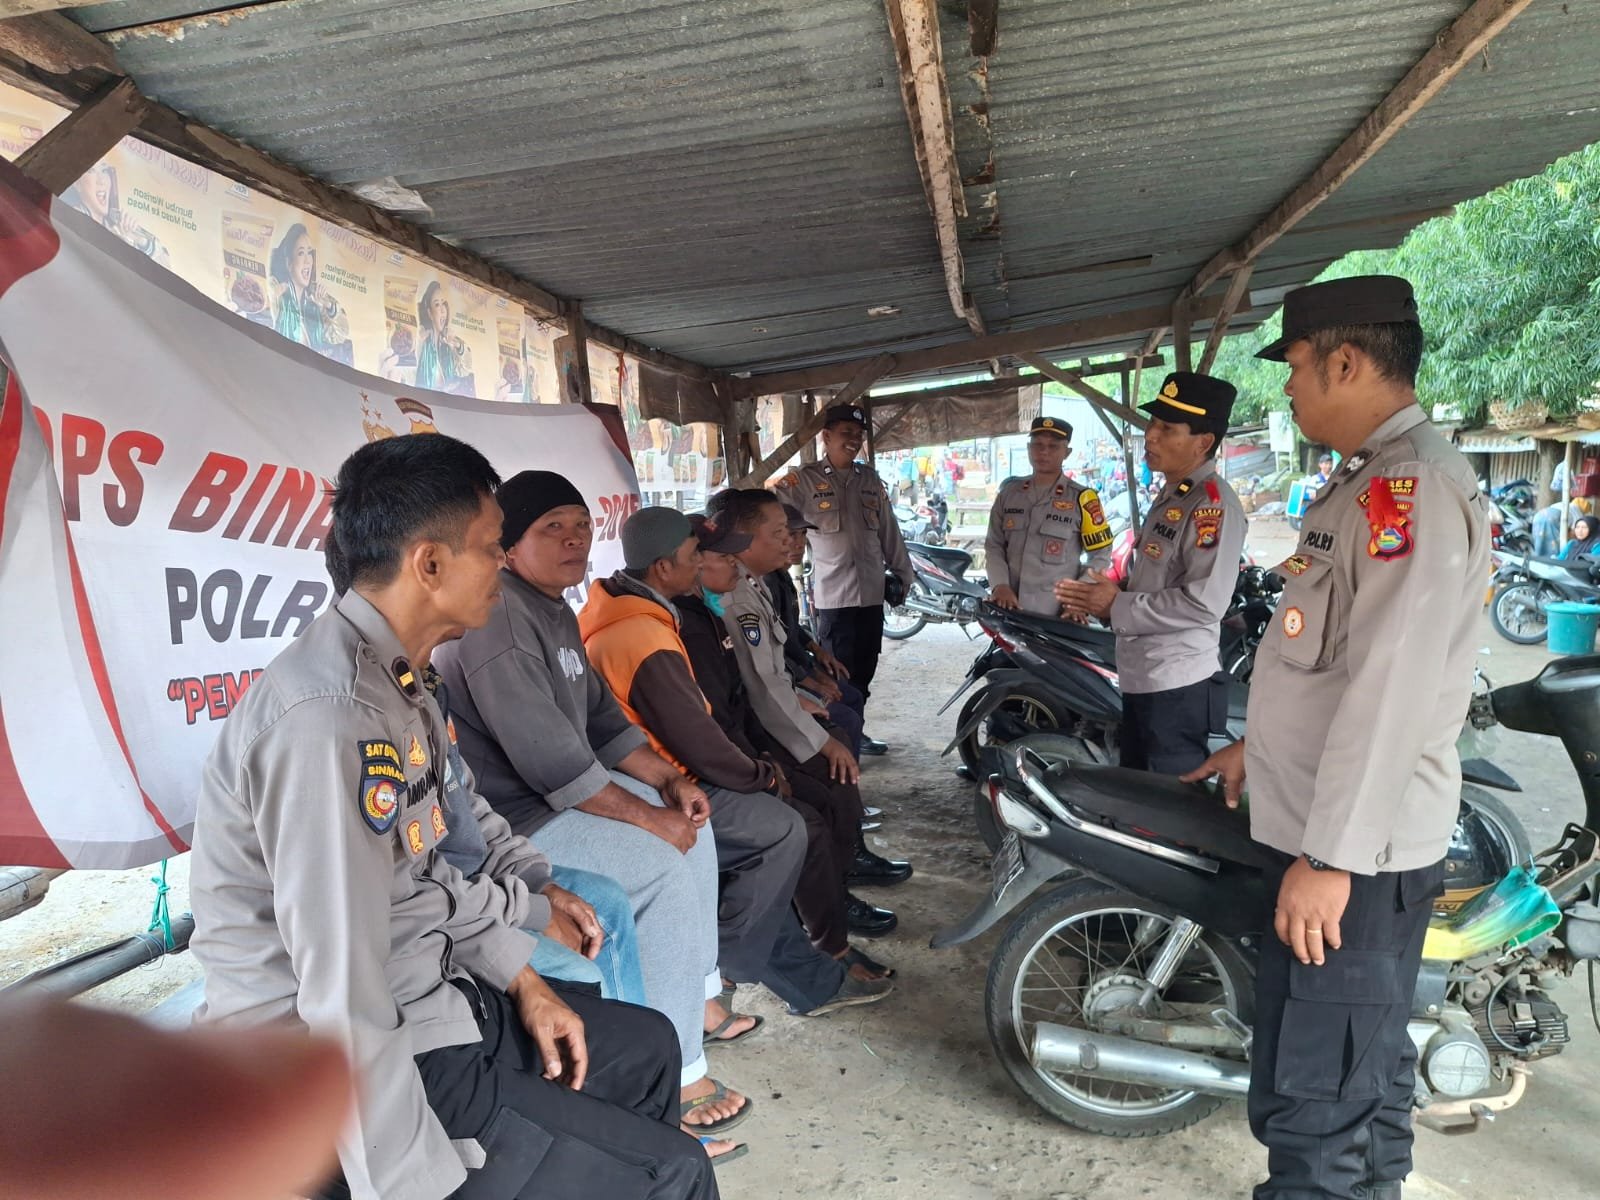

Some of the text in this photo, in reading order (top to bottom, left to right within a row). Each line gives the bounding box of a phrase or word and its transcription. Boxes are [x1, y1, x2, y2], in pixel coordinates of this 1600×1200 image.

[1046, 513, 1072, 525] POLRI
[1152, 522, 1177, 541] POLRI
[1303, 531, 1335, 551] POLRI
[165, 566, 328, 645] POLR
[366, 743, 384, 757] SAT
